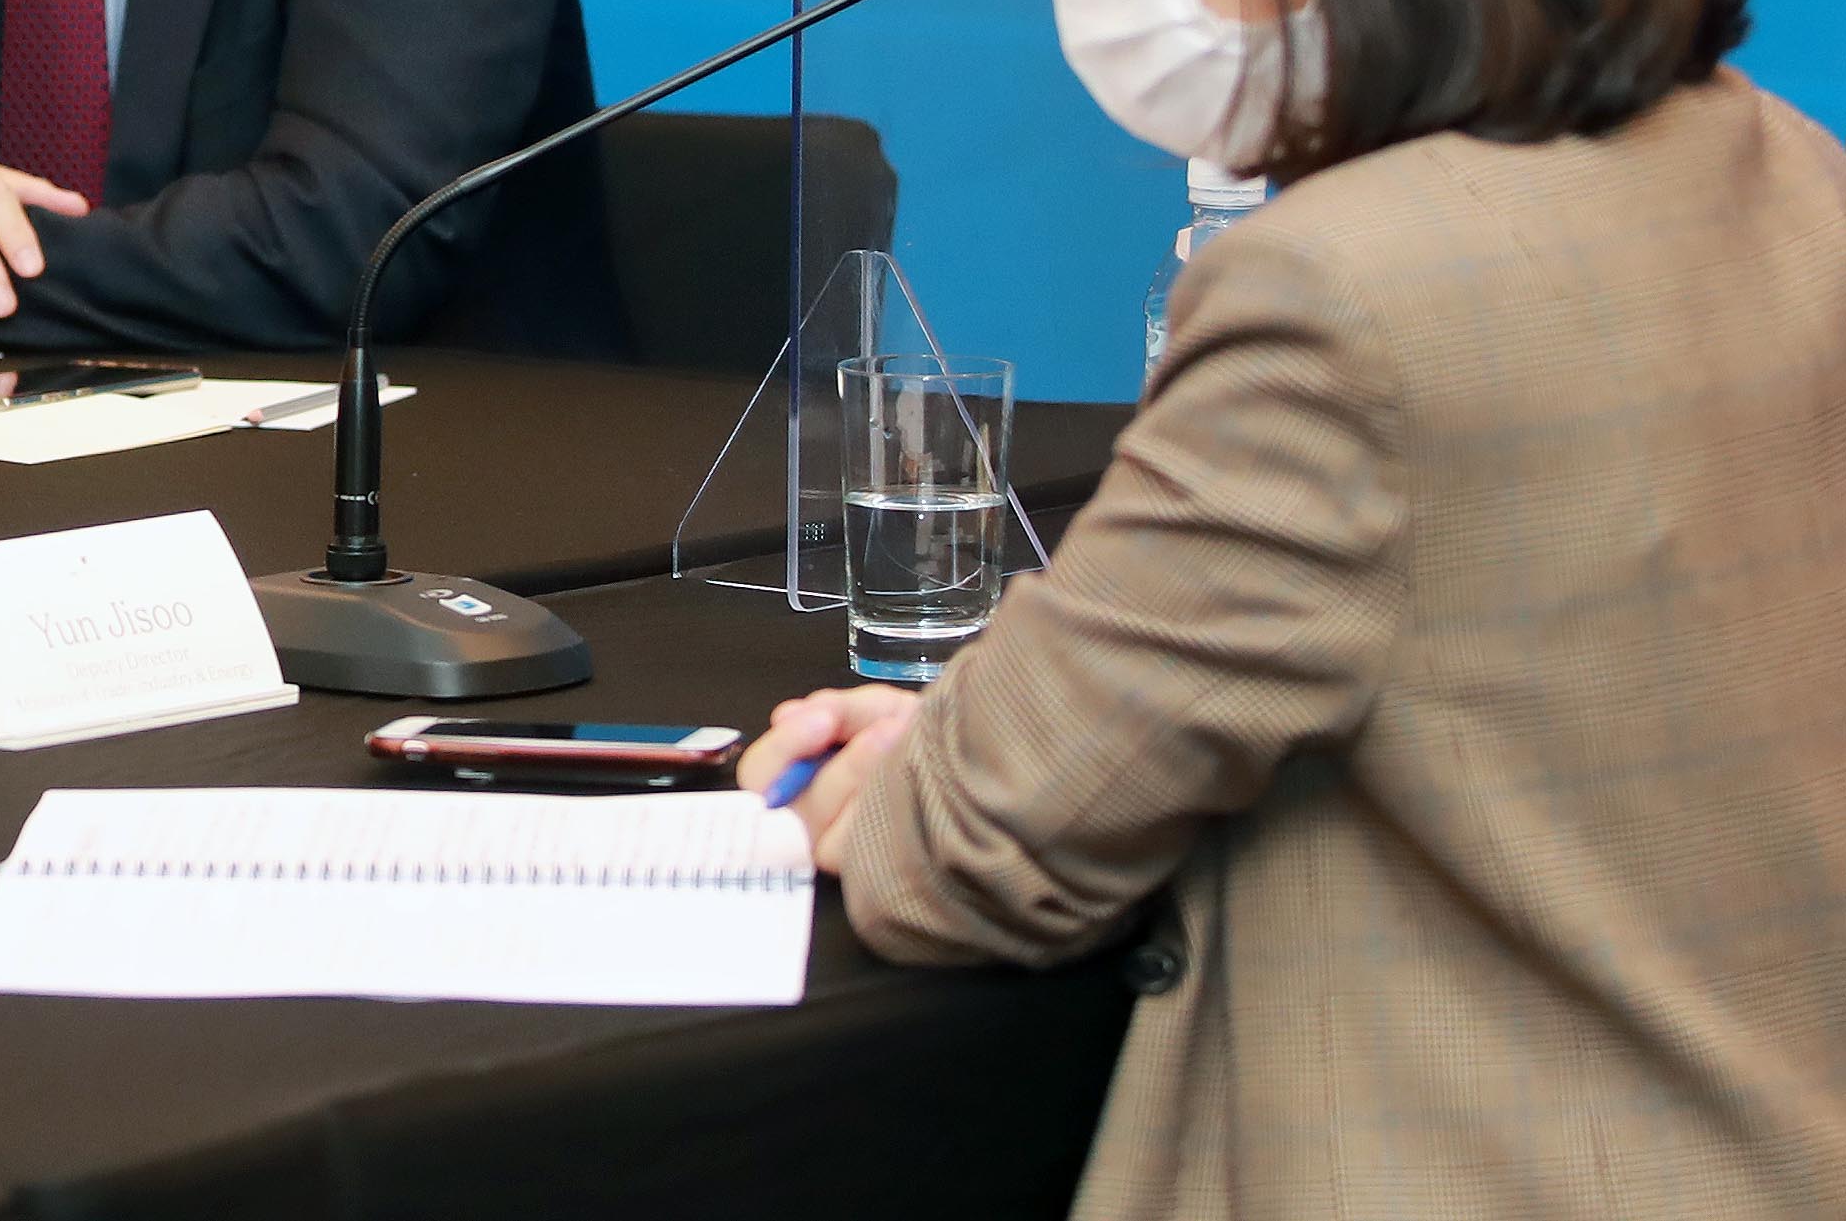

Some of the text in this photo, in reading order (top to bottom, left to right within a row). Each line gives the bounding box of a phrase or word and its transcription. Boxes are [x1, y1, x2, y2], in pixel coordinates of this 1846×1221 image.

[28, 599, 194, 649] Yun Jisoo
[125, 646, 190, 671] Director
